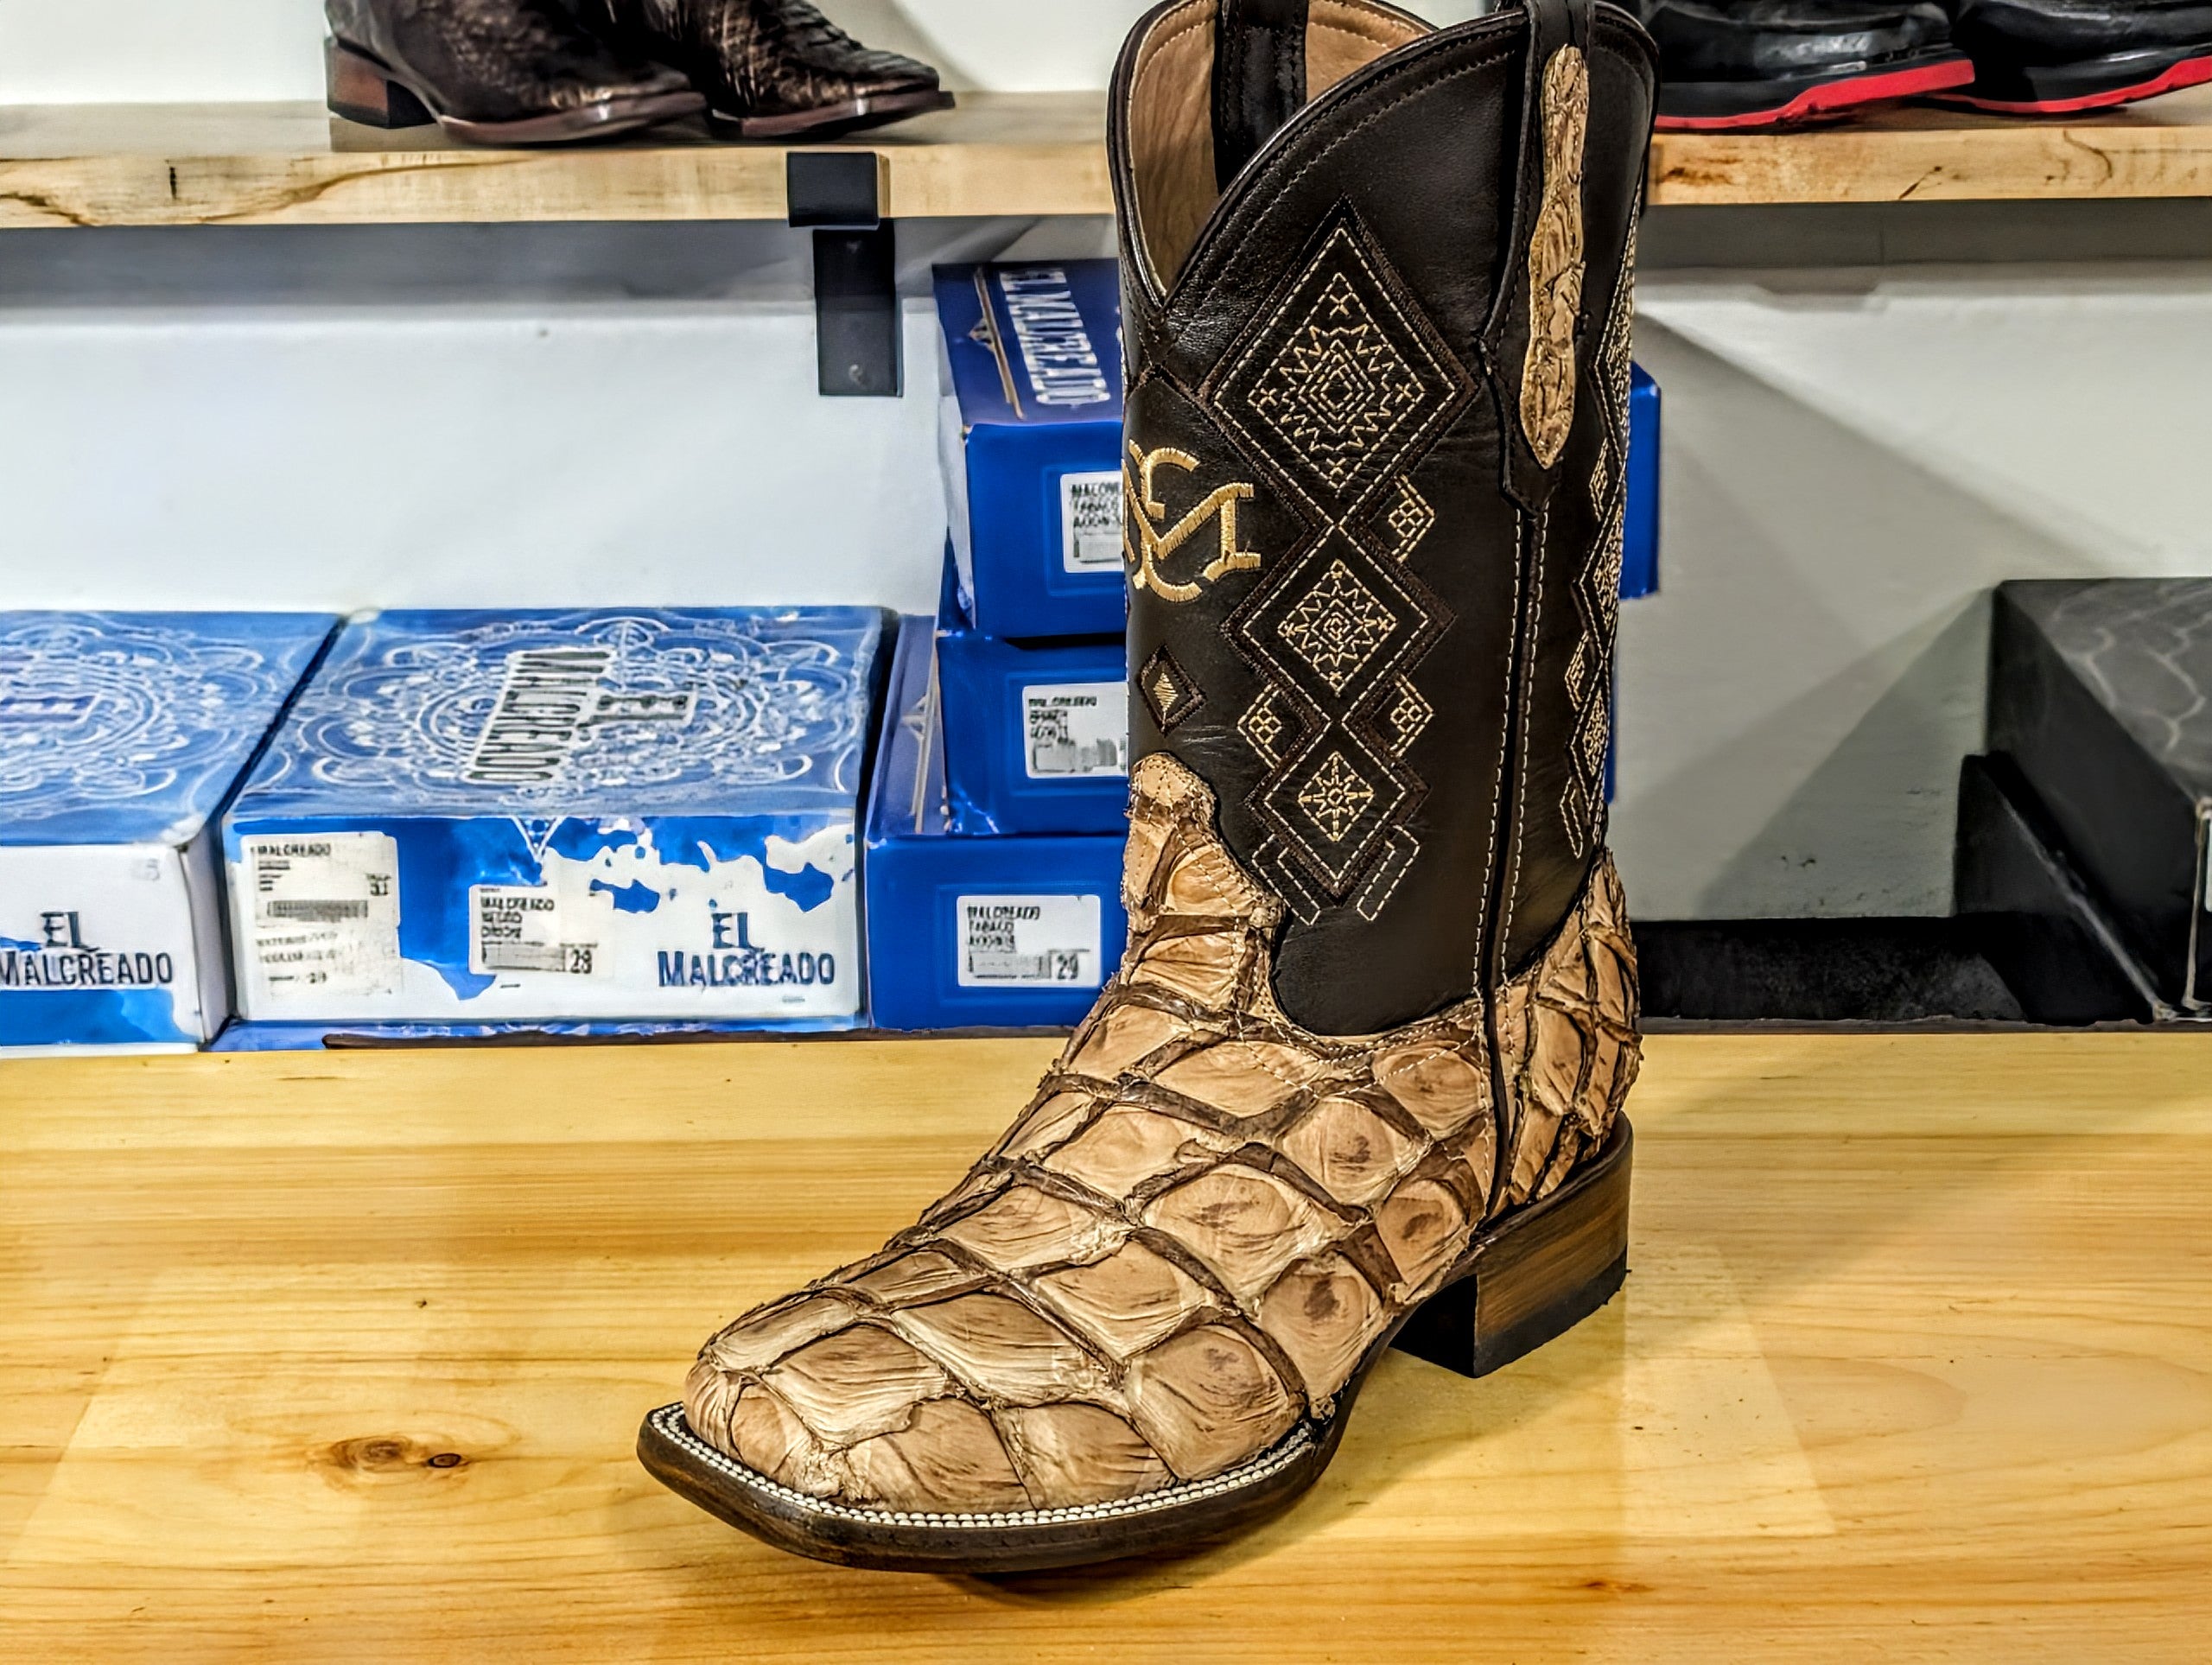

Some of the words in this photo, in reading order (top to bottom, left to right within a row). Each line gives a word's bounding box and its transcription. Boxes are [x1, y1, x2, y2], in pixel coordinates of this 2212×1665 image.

[467, 650, 612, 781] MALCREADO
[41, 911, 99, 952] EL
[711, 911, 766, 953] EL
[657, 950, 836, 988] MALCREADO
